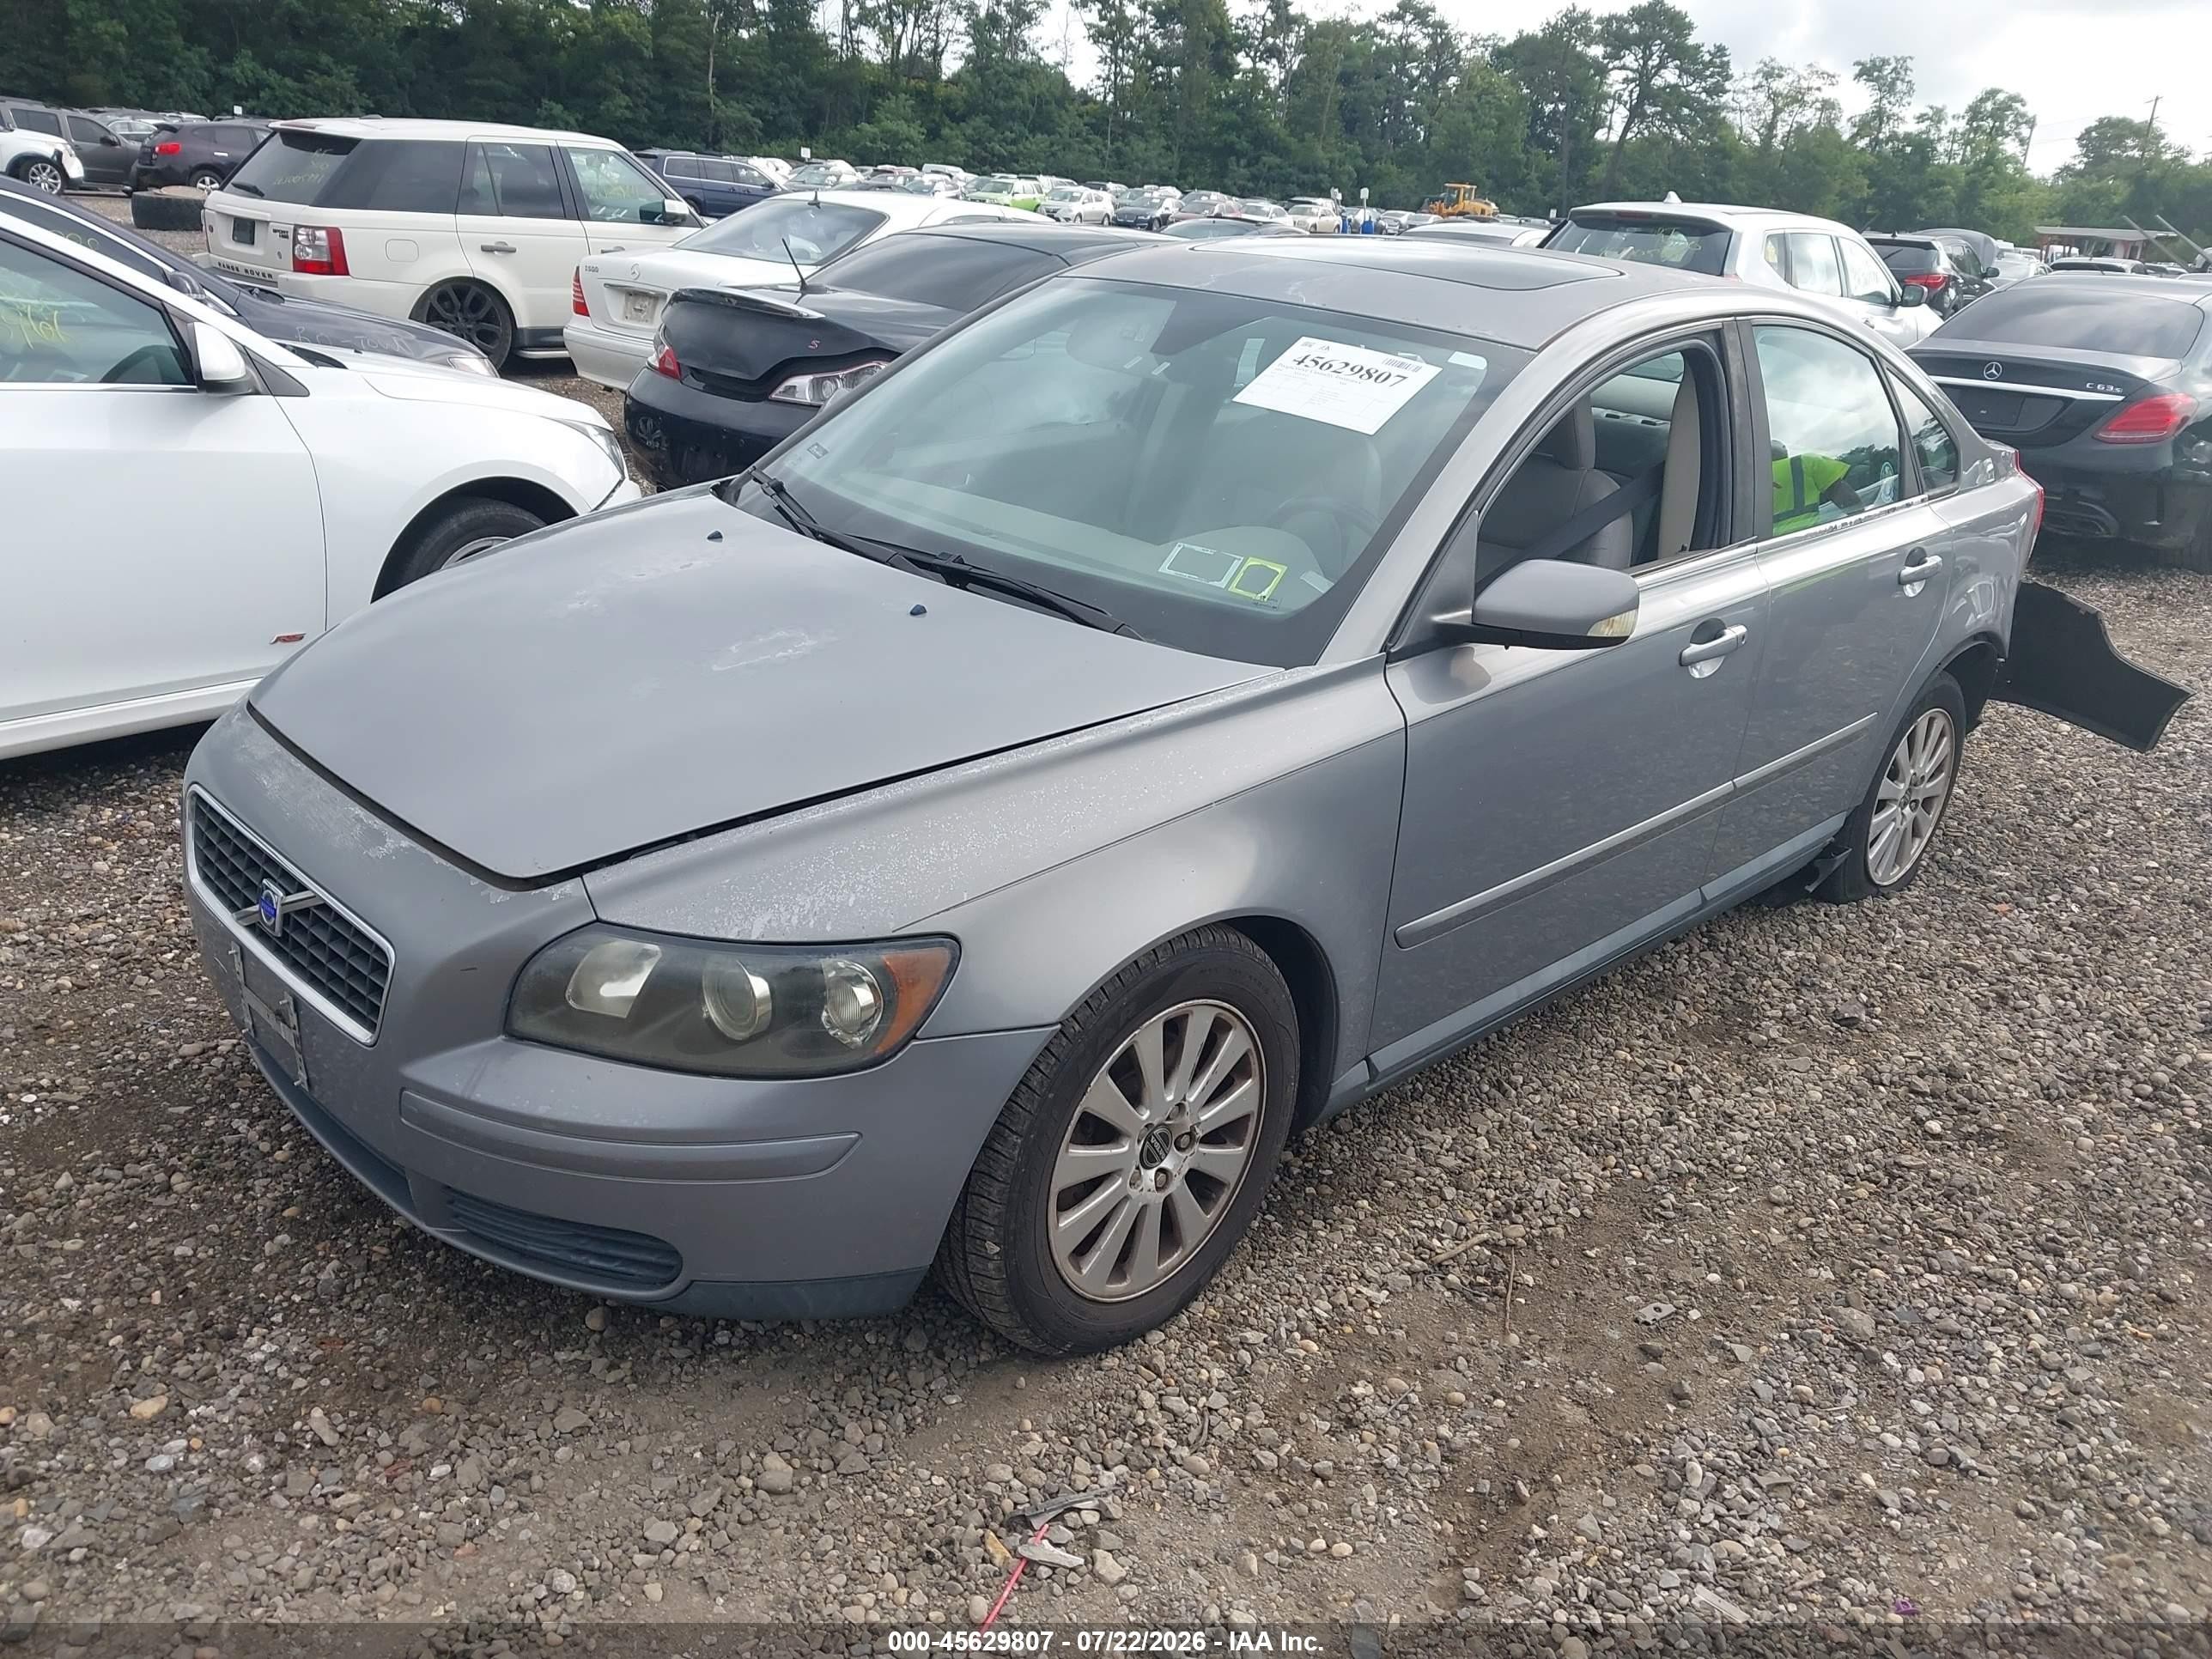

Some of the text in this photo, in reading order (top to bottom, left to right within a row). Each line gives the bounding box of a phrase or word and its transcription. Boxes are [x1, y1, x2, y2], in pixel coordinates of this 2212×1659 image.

[245, 268, 273, 280] ROVER
[808, 339, 820, 349] S
[1291, 354, 1408, 387] 45629807
[1151, 1134, 1167, 1160] VOLVO
